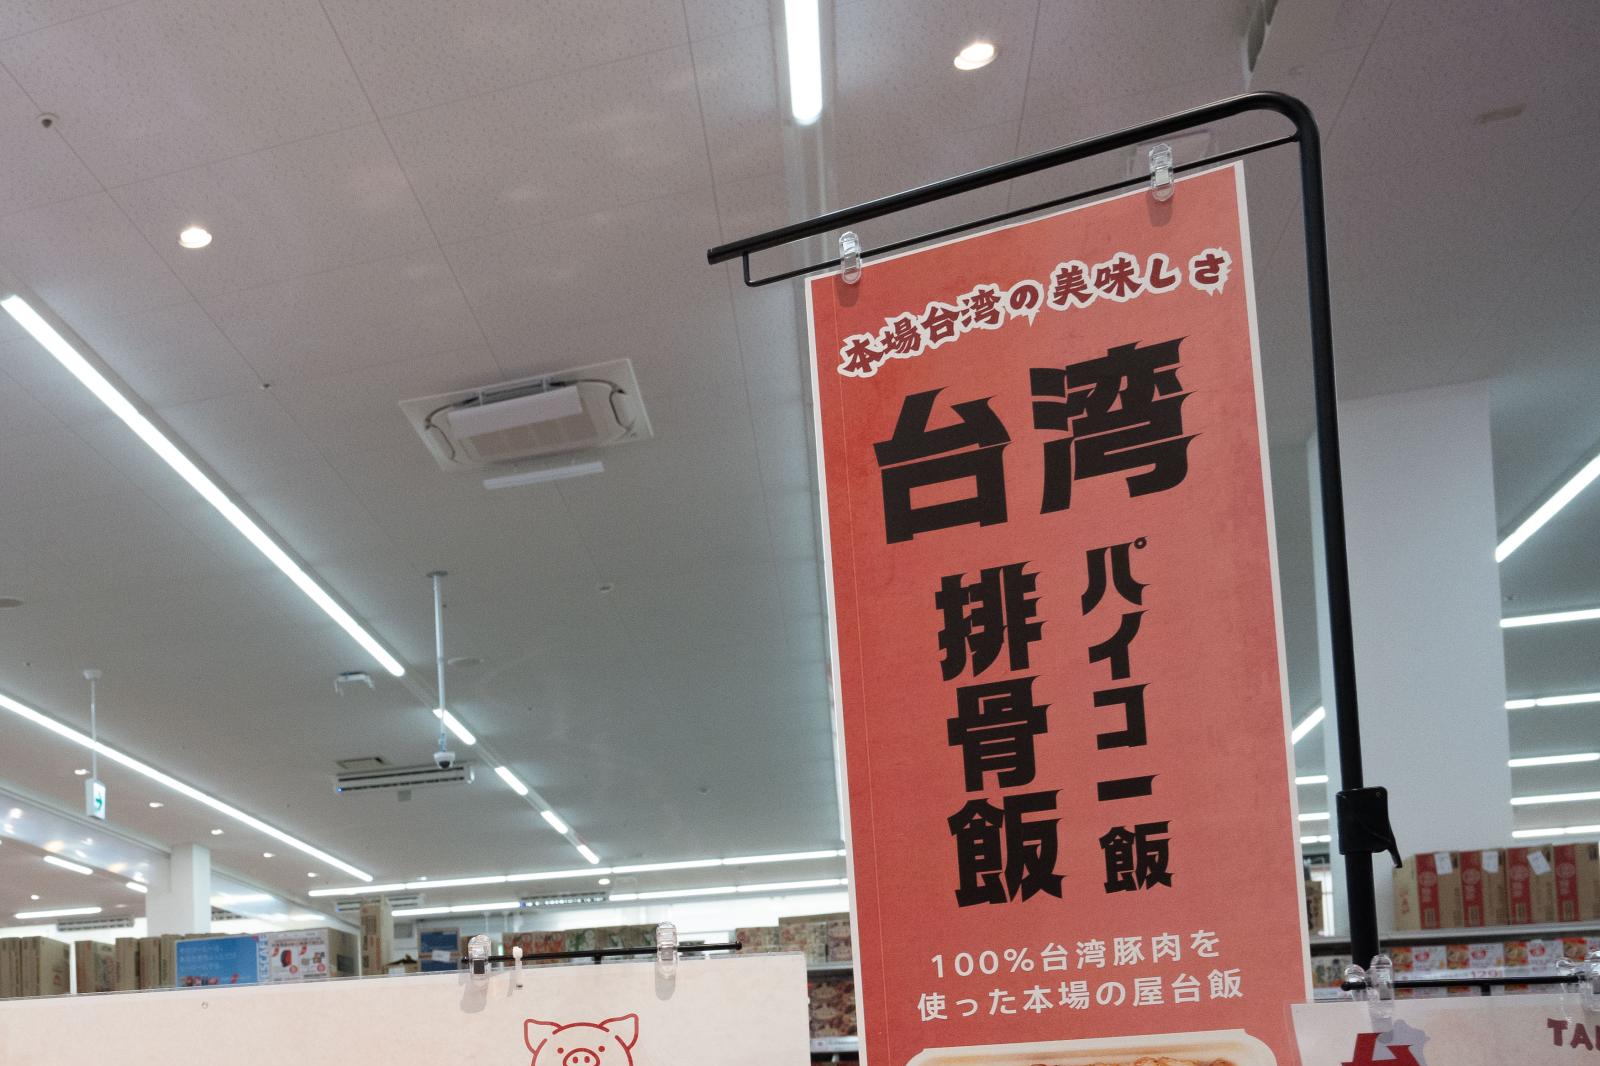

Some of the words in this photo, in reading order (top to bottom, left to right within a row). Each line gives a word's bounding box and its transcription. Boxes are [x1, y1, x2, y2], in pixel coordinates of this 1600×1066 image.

[842, 250, 1230, 377] 本場台湾の美味しさ
[873, 336, 1203, 545] 台湾
[935, 560, 1069, 909] 排骨飯
[1081, 535, 1173, 895] パイコー飯
[917, 968, 1244, 1022] 使った本場の屋台飯
[931, 929, 1221, 979] 100%台湾豚肉を
